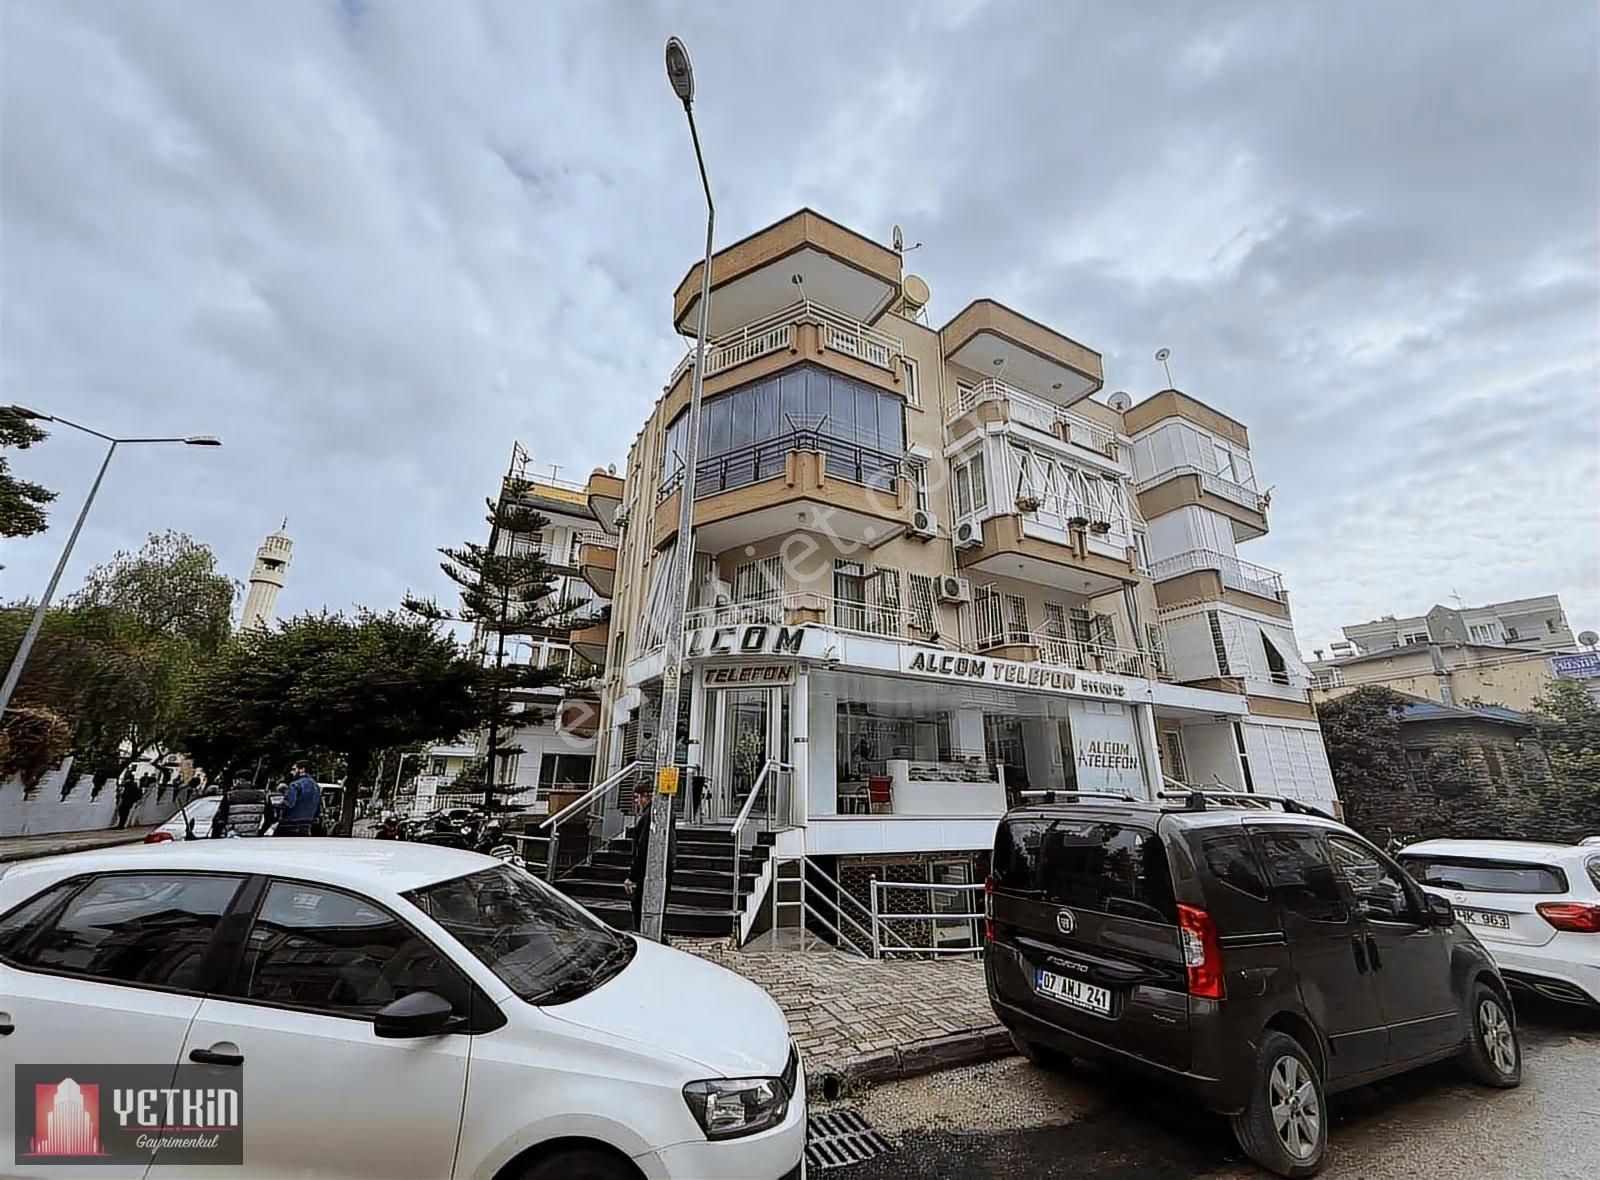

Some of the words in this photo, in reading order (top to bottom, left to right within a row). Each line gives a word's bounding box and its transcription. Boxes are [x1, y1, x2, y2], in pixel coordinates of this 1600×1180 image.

[688, 627, 805, 657] LCOM
[704, 665, 793, 684] TELEFON
[909, 652, 986, 679] ALCOM
[992, 662, 1076, 691] TELEFON
[1088, 741, 1130, 756] ALCOM
[1087, 754, 1138, 770] TELEFON
[1482, 913, 1506, 926] 963
[1043, 973, 1057, 990] 07
[1086, 986, 1107, 1008] 241
